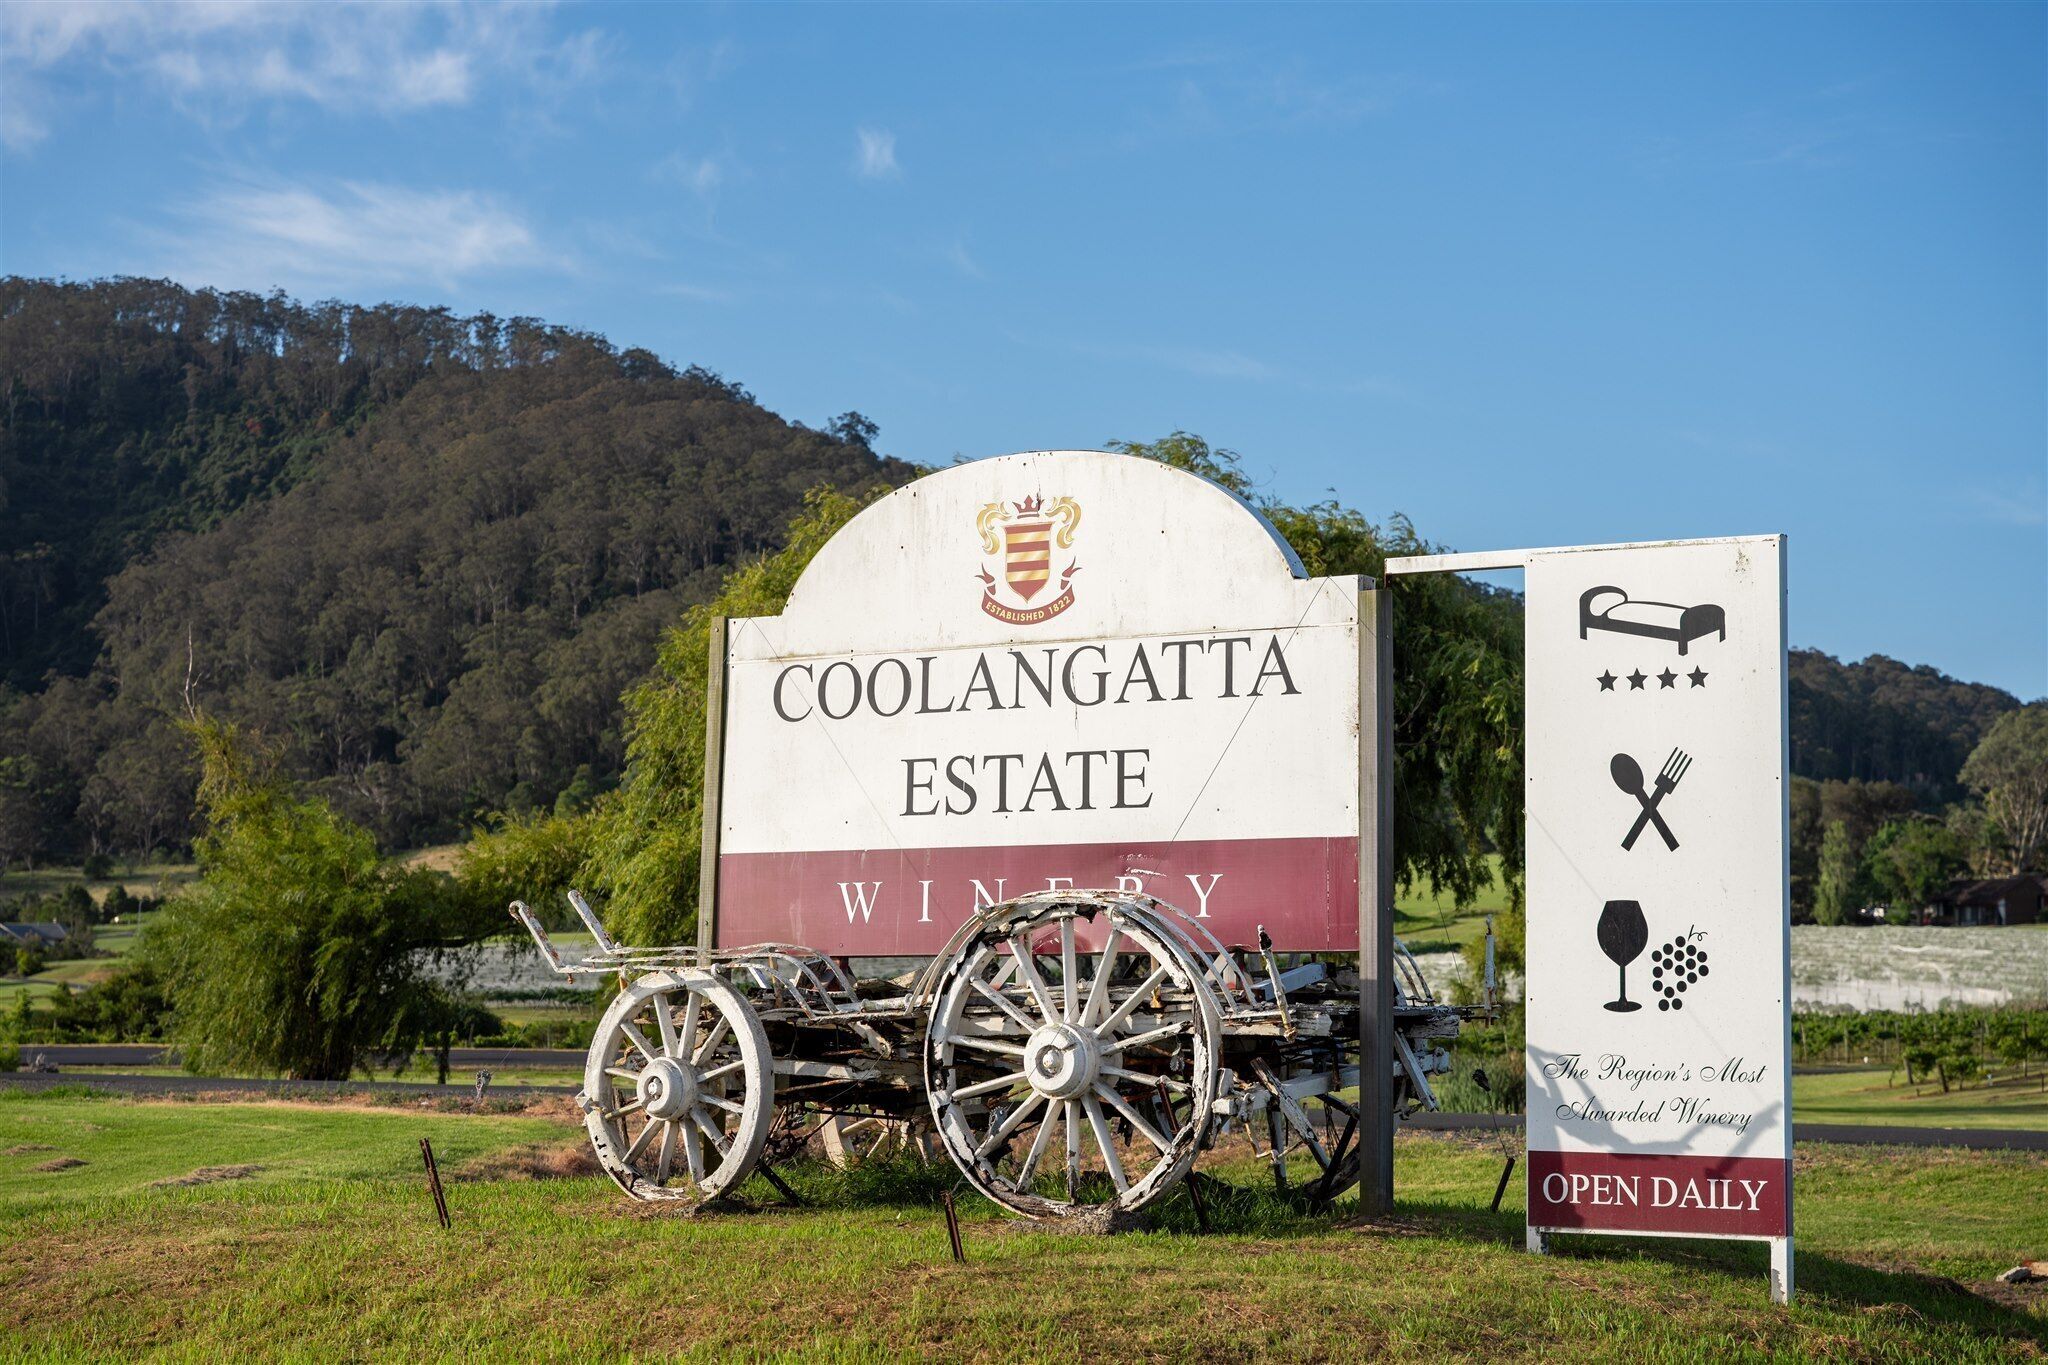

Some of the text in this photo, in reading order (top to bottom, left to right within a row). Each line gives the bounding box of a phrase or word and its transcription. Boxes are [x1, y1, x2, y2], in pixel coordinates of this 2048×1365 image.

[985, 595, 1071, 622] ESTABLISHED 1822
[773, 634, 1302, 722] COOLANGATTA
[900, 748, 1154, 817] ESTATE
[1543, 1053, 1768, 1091] The Region's Most
[1556, 1096, 1752, 1135] Awarded Winery
[1542, 1173, 1768, 1211] OPEN DAILY
